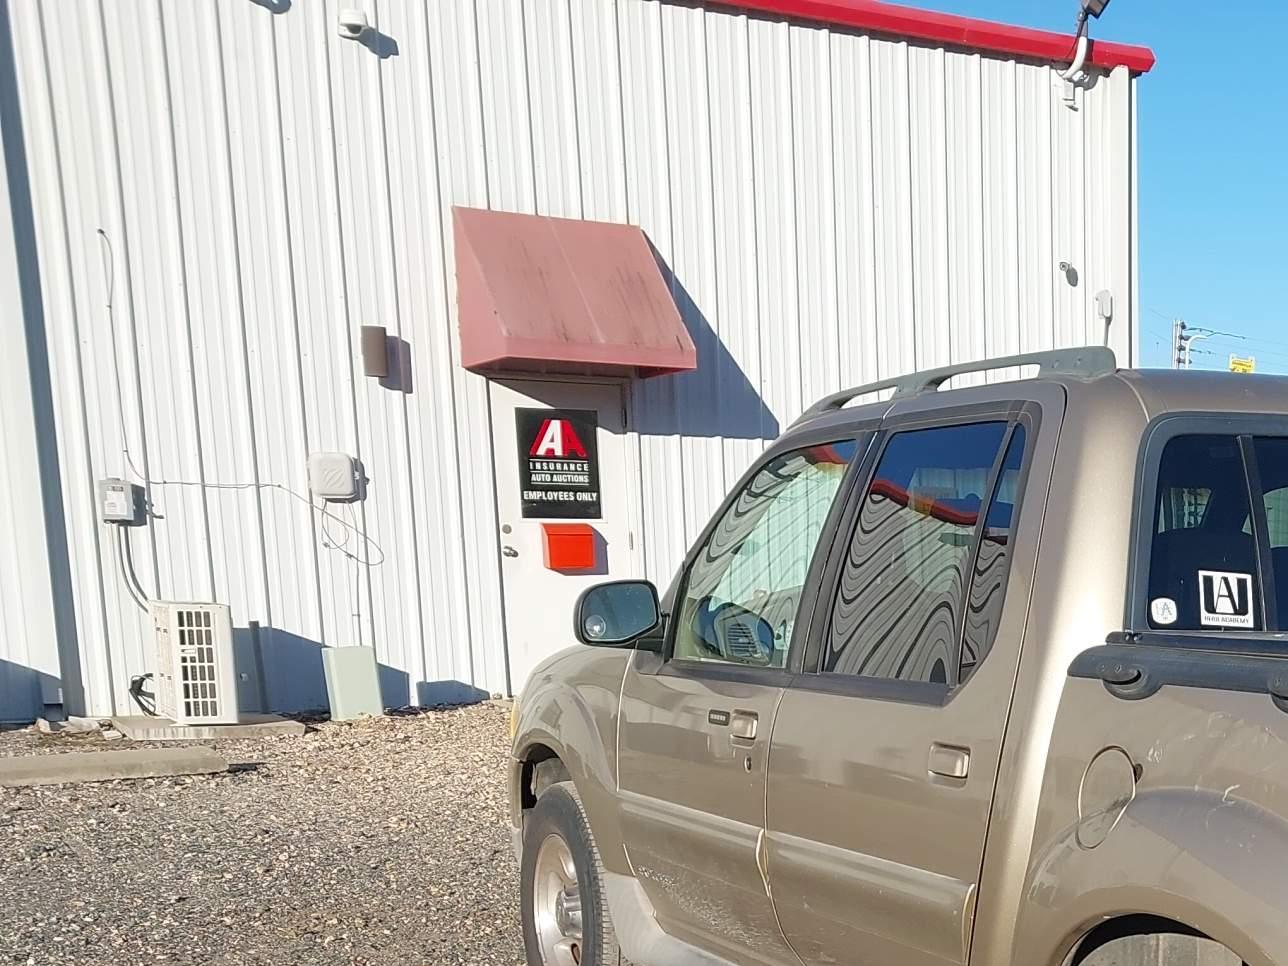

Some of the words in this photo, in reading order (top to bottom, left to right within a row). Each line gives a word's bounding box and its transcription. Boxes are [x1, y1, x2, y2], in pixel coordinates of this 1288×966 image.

[529, 461, 589, 472] INSURANCE
[531, 473, 551, 482] AUTO
[552, 474, 589, 483] AUCTIONS
[523, 490, 575, 501] EMPLOYEES
[576, 492, 597, 502] ONLY
